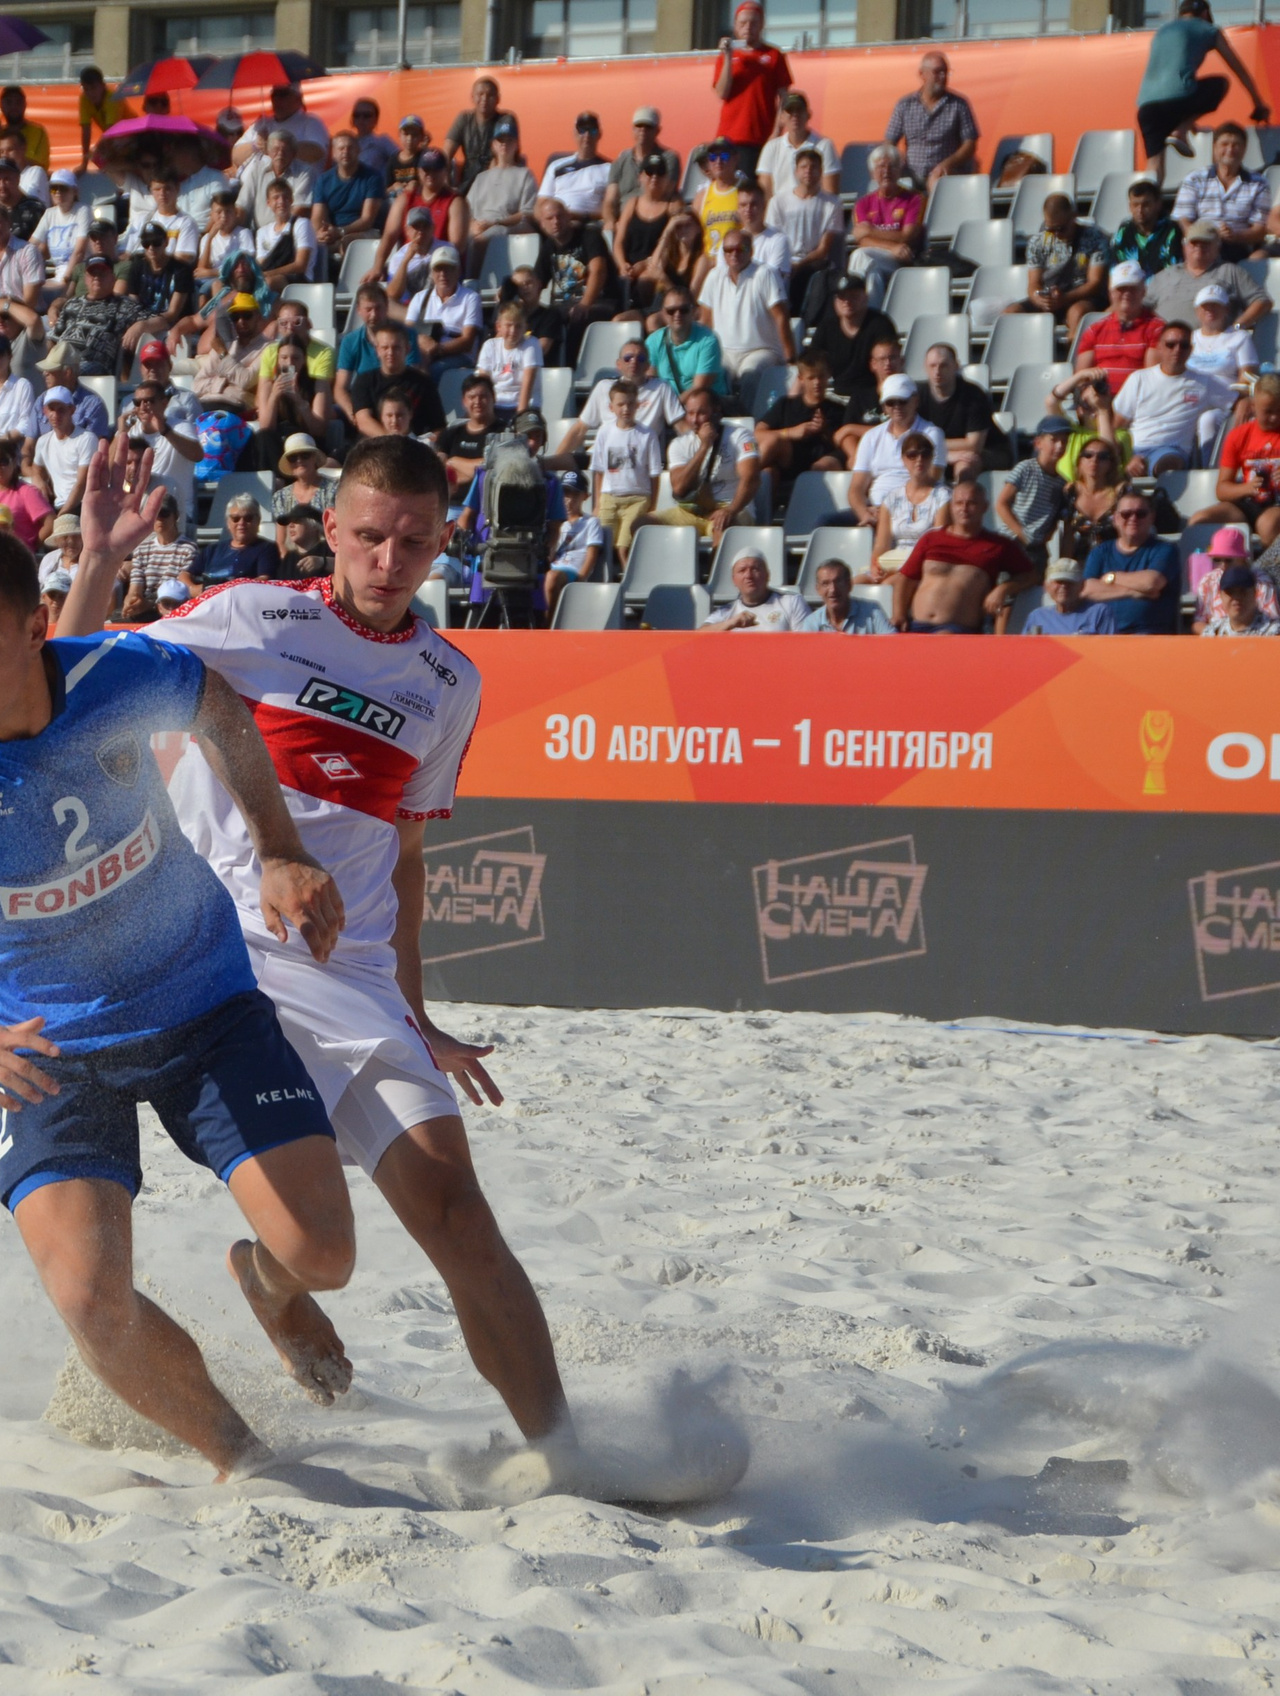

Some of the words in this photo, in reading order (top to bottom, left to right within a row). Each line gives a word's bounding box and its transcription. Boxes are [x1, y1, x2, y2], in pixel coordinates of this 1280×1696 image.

[300, 681, 402, 737] PARI
[394, 693, 436, 718] ХИМЧИСТК
[544, 713, 596, 760] 30
[607, 725, 743, 763] АВГУСТА
[793, 719, 811, 766] 1
[824, 729, 993, 769] СЕНТЯБРЯ
[52, 796, 99, 863] 2
[8, 824, 156, 916] FONBET
[767, 859, 903, 909] НАША
[422, 894, 532, 931] МЕНА
[759, 902, 910, 943] СМЕНА
[256, 1087, 315, 1105] KELME
